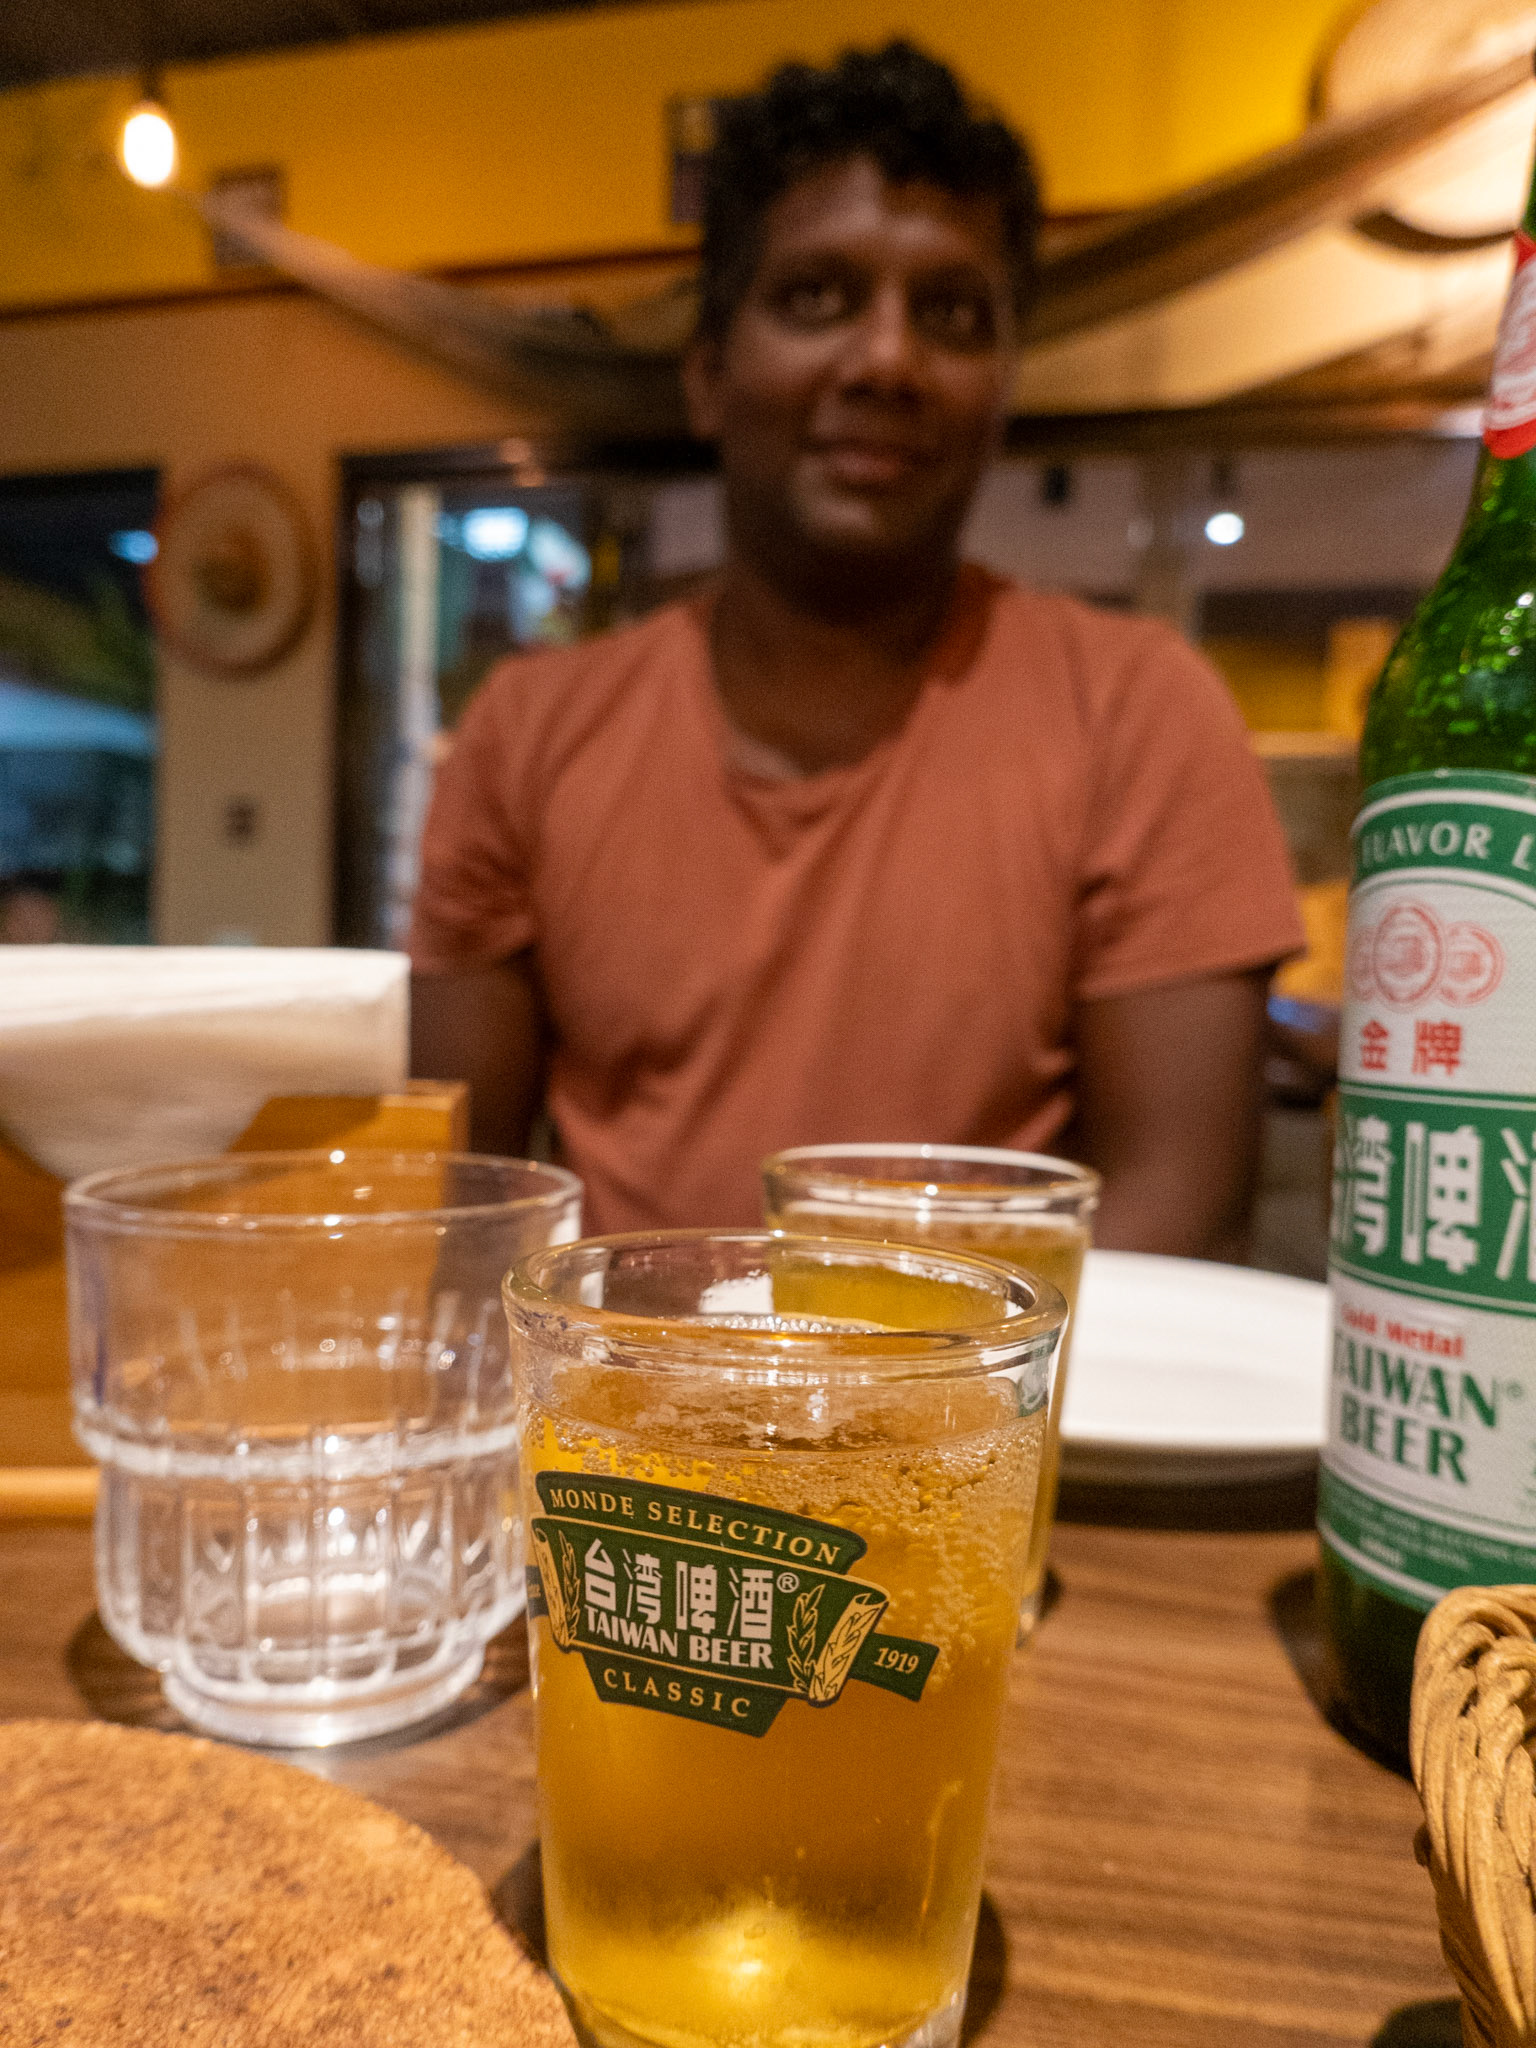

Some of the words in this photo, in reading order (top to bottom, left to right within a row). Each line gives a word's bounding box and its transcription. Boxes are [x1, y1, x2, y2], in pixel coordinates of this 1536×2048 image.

[1341, 1392, 1468, 1484] BEER
[549, 1488, 635, 1517] MONDE
[647, 1501, 841, 1566] SELECTION
[584, 1604, 678, 1658] TAIWAN
[689, 1634, 774, 1670] BEER
[873, 1647, 920, 1675] 1919
[603, 1668, 751, 1718] CLASSIC
